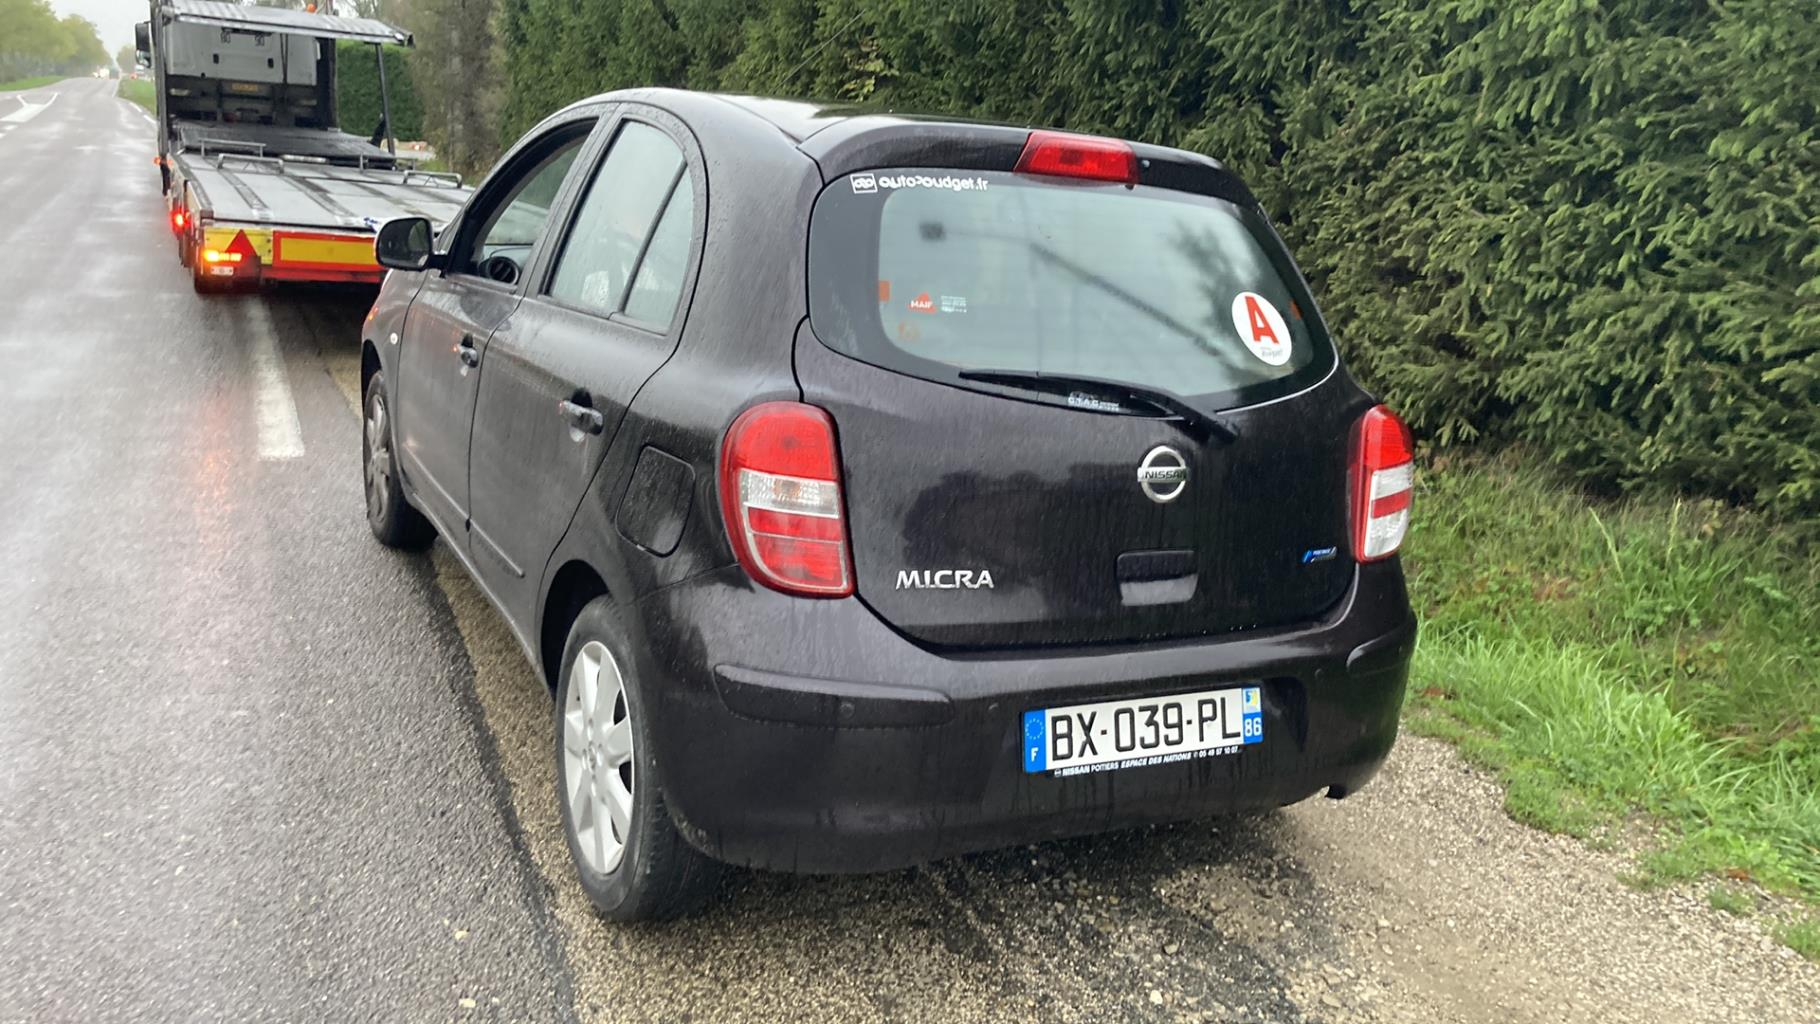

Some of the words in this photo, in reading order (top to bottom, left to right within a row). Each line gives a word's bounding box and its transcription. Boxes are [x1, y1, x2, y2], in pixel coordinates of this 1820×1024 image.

[1244, 294, 1280, 345] A
[1145, 468, 1187, 479] NISSAN
[895, 569, 994, 590] MICRA
[1030, 747, 1039, 762] F
[1244, 718, 1262, 737] 86
[1062, 764, 1090, 776] NISSAN
[1091, 761, 1119, 773] POITIERS
[1121, 756, 1148, 769] ESPACE
[1148, 755, 1162, 766] DES
[1163, 751, 1192, 763] NATIONS
